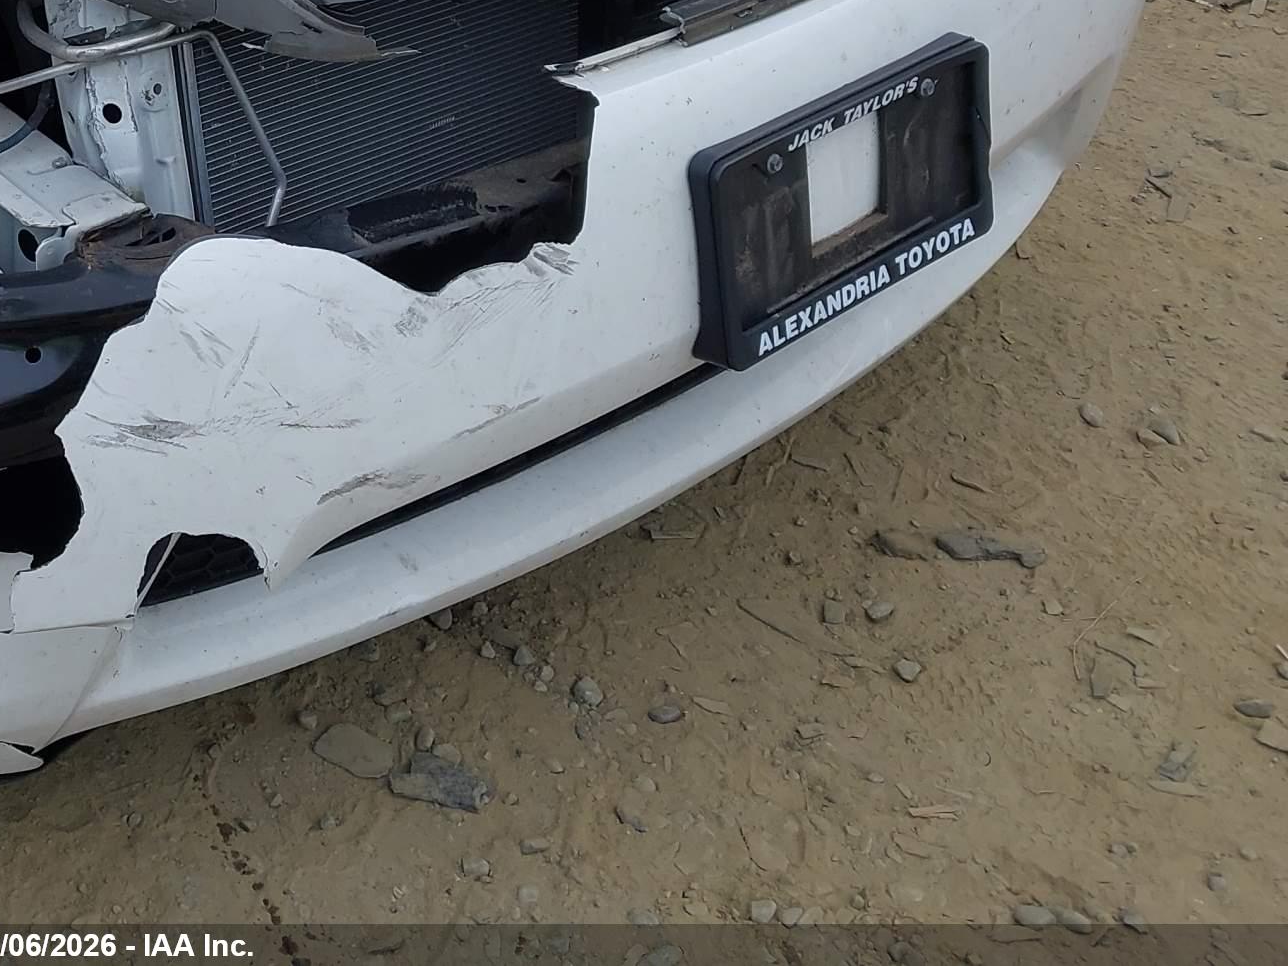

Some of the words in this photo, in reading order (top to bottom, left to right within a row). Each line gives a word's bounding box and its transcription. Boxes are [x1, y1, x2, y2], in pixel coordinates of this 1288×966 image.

[788, 117, 835, 151] JACK
[843, 76, 919, 125] TAYLOR'S
[758, 264, 890, 356] ALEXANDRIA
[895, 218, 975, 275] TOYOTA
